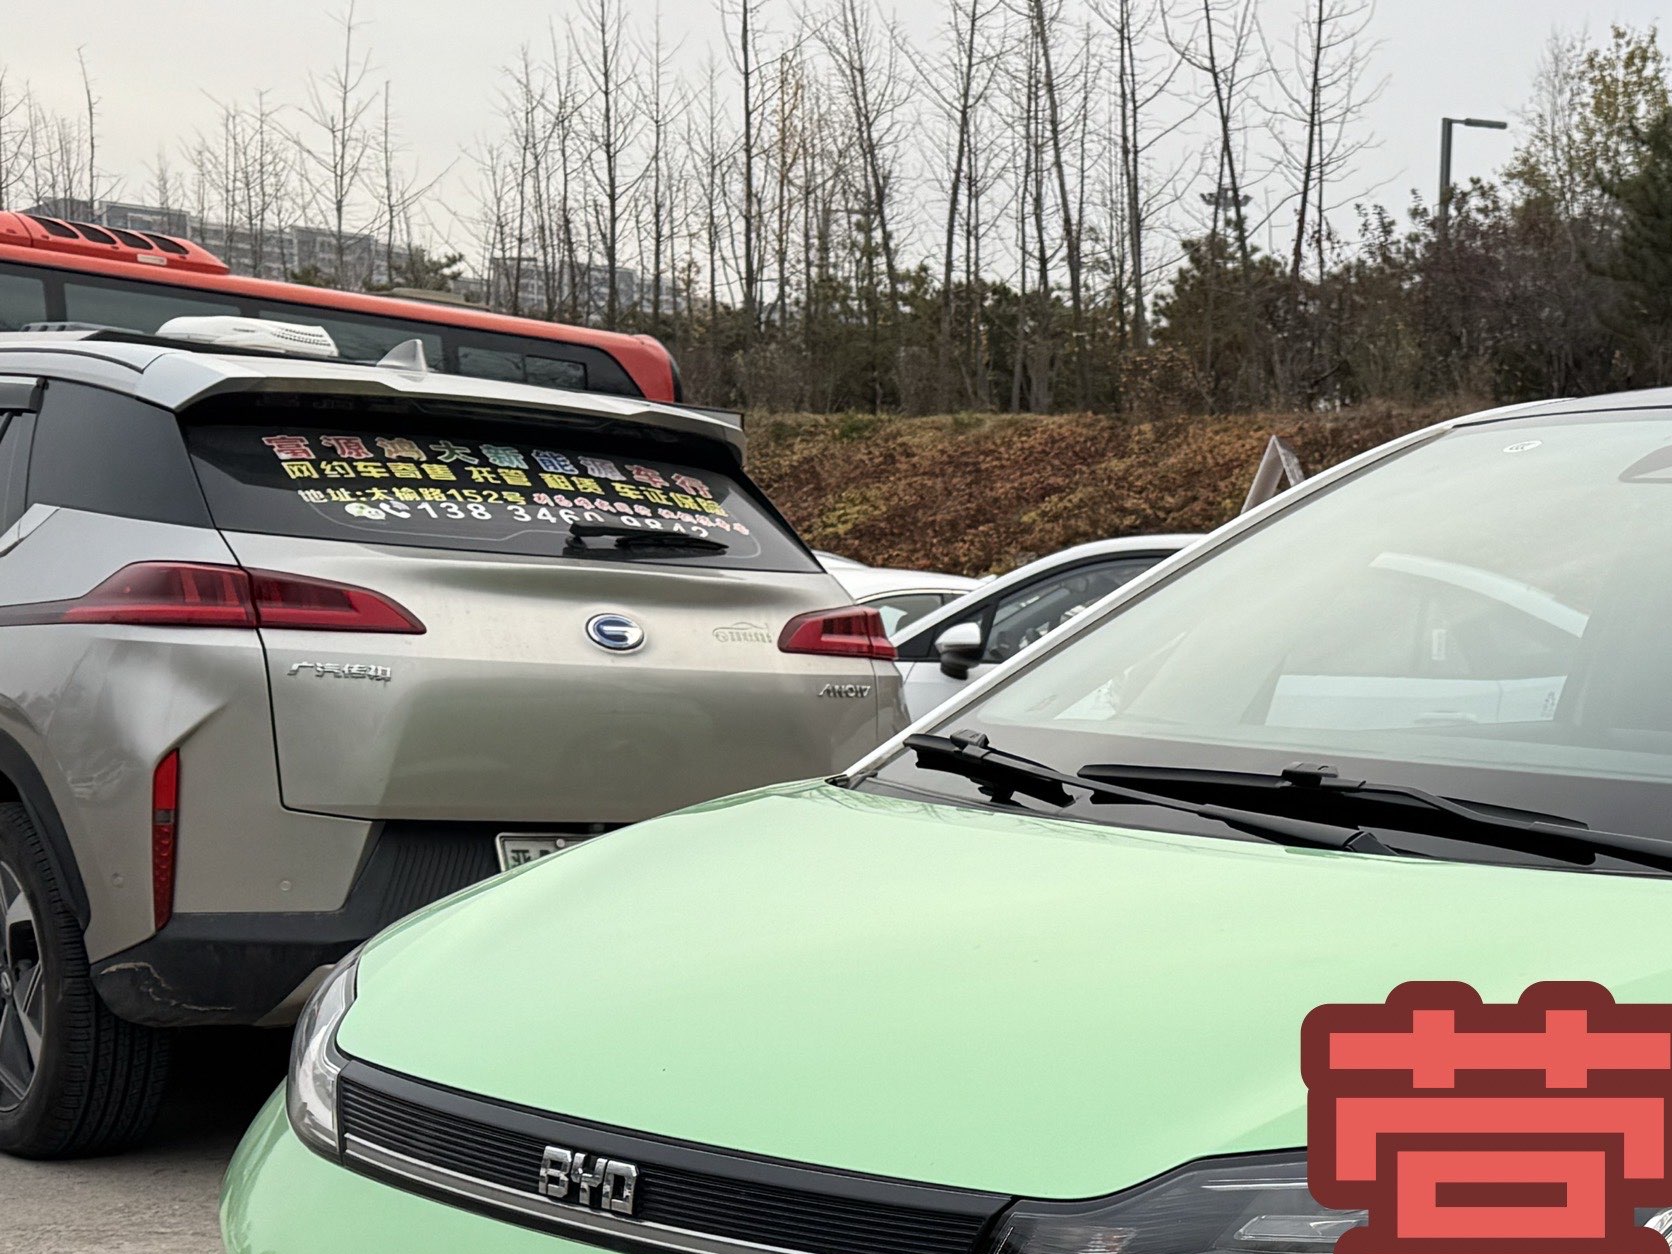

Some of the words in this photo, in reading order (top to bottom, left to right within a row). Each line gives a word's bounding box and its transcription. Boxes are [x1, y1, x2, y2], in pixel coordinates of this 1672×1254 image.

[281, 461, 457, 481] 网约车寄售
[465, 466, 532, 487] 托管
[538, 472, 605, 495] 租赁
[611, 482, 729, 517] 车证保险
[417, 501, 492, 520] 138
[539, 1146, 638, 1215] BYD
